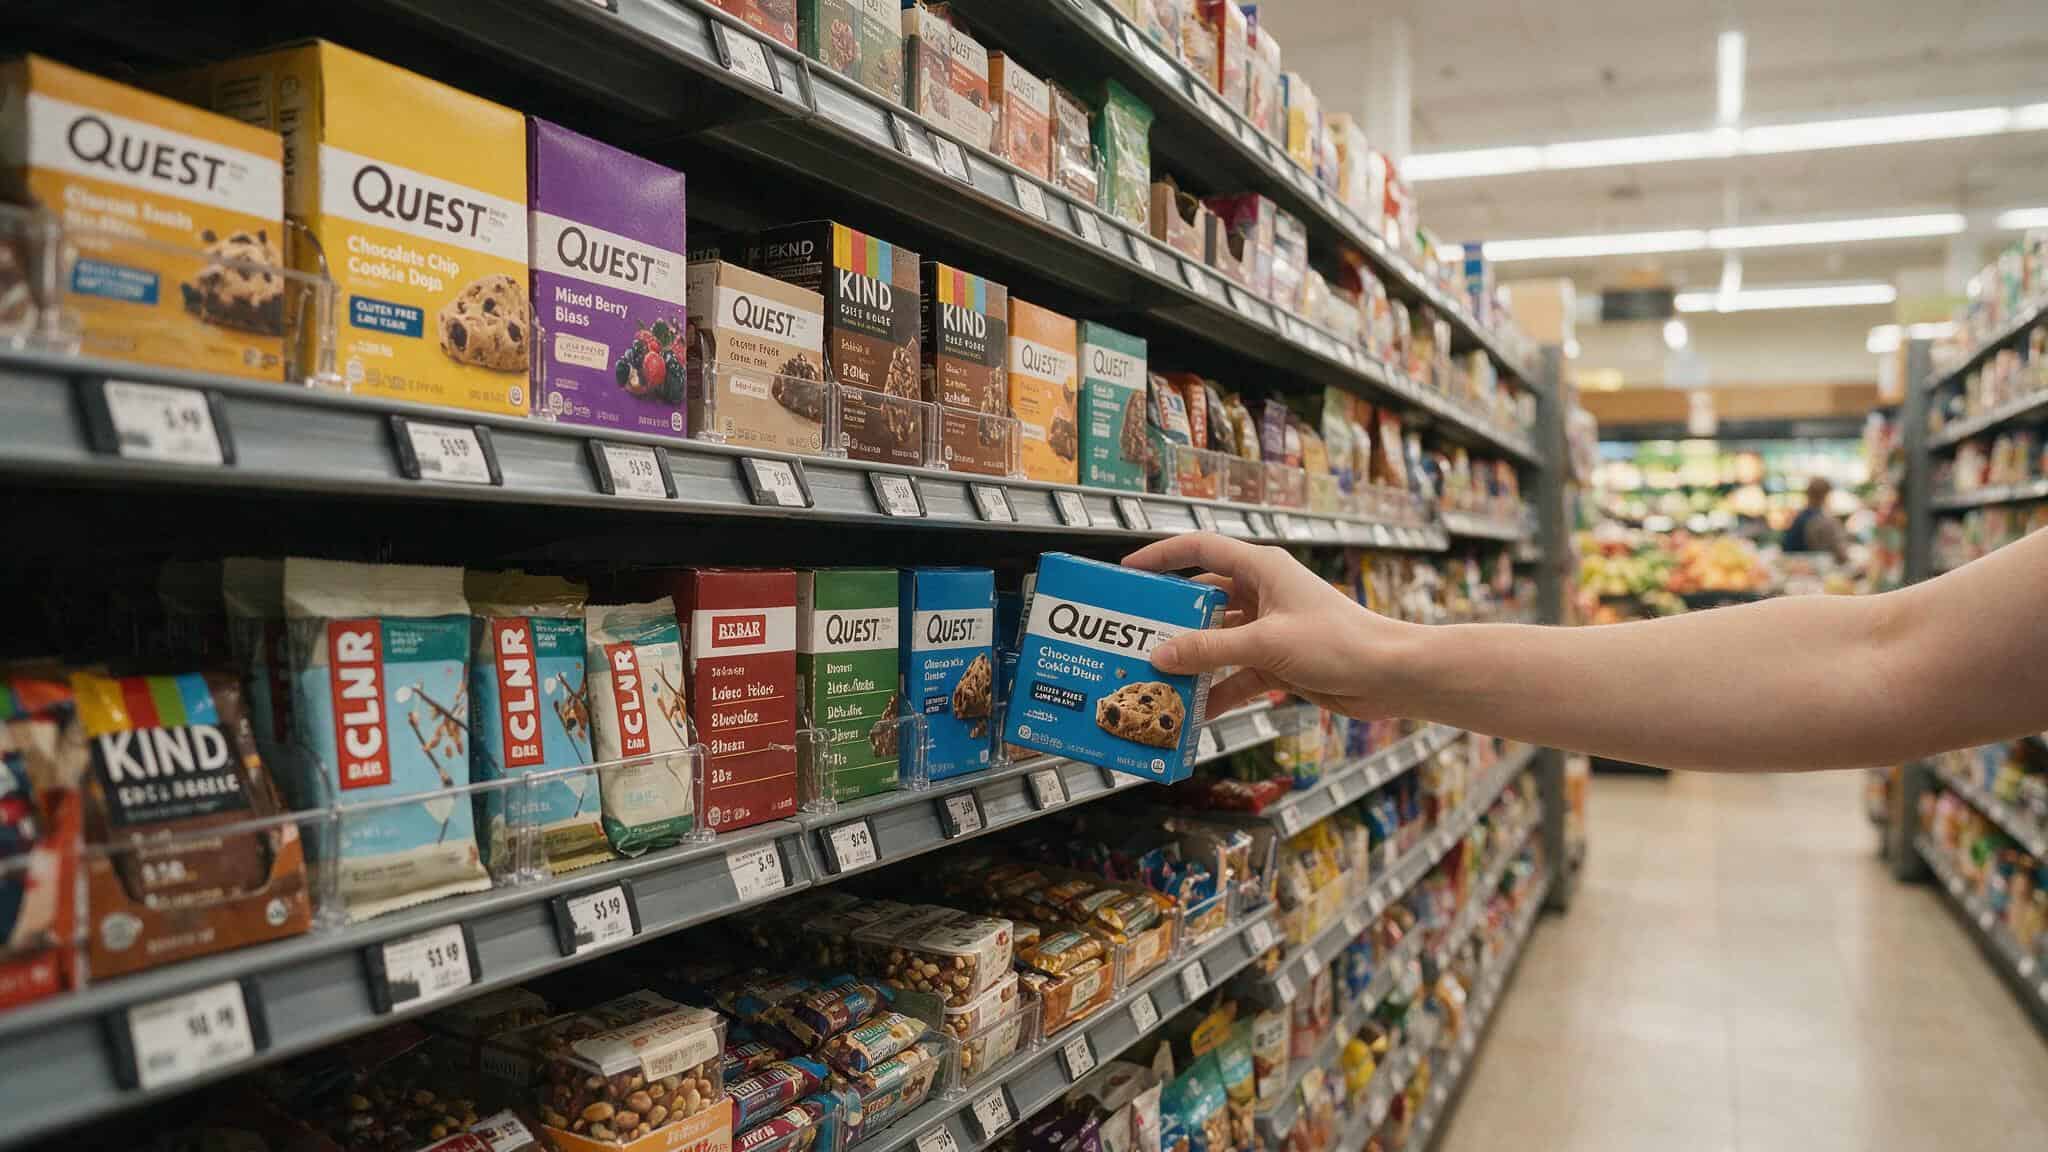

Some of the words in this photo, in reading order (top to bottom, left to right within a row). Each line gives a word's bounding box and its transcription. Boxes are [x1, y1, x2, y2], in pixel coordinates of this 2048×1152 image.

[68, 115, 226, 191] QUEST
[353, 164, 488, 238] QUEST
[347, 235, 426, 269] Chocolate
[427, 252, 461, 280] Chip
[347, 257, 405, 284] Cookie
[557, 226, 656, 286] QUEST
[555, 286, 593, 310] Mixed
[595, 294, 629, 319] Berry
[839, 268, 894, 312] KIND
[732, 295, 796, 337] QUEST
[943, 303, 988, 338] KIND
[1021, 344, 1059, 377] QUEST
[1093, 349, 1129, 377] QUEST
[826, 614, 880, 645] QUEST
[926, 614, 976, 644] QUEST
[1048, 603, 1158, 651] QUEST
[337, 630, 383, 759] CLNR
[501, 628, 538, 741] CLNR
[614, 648, 645, 735] CLNR
[101, 724, 230, 783] KIND
